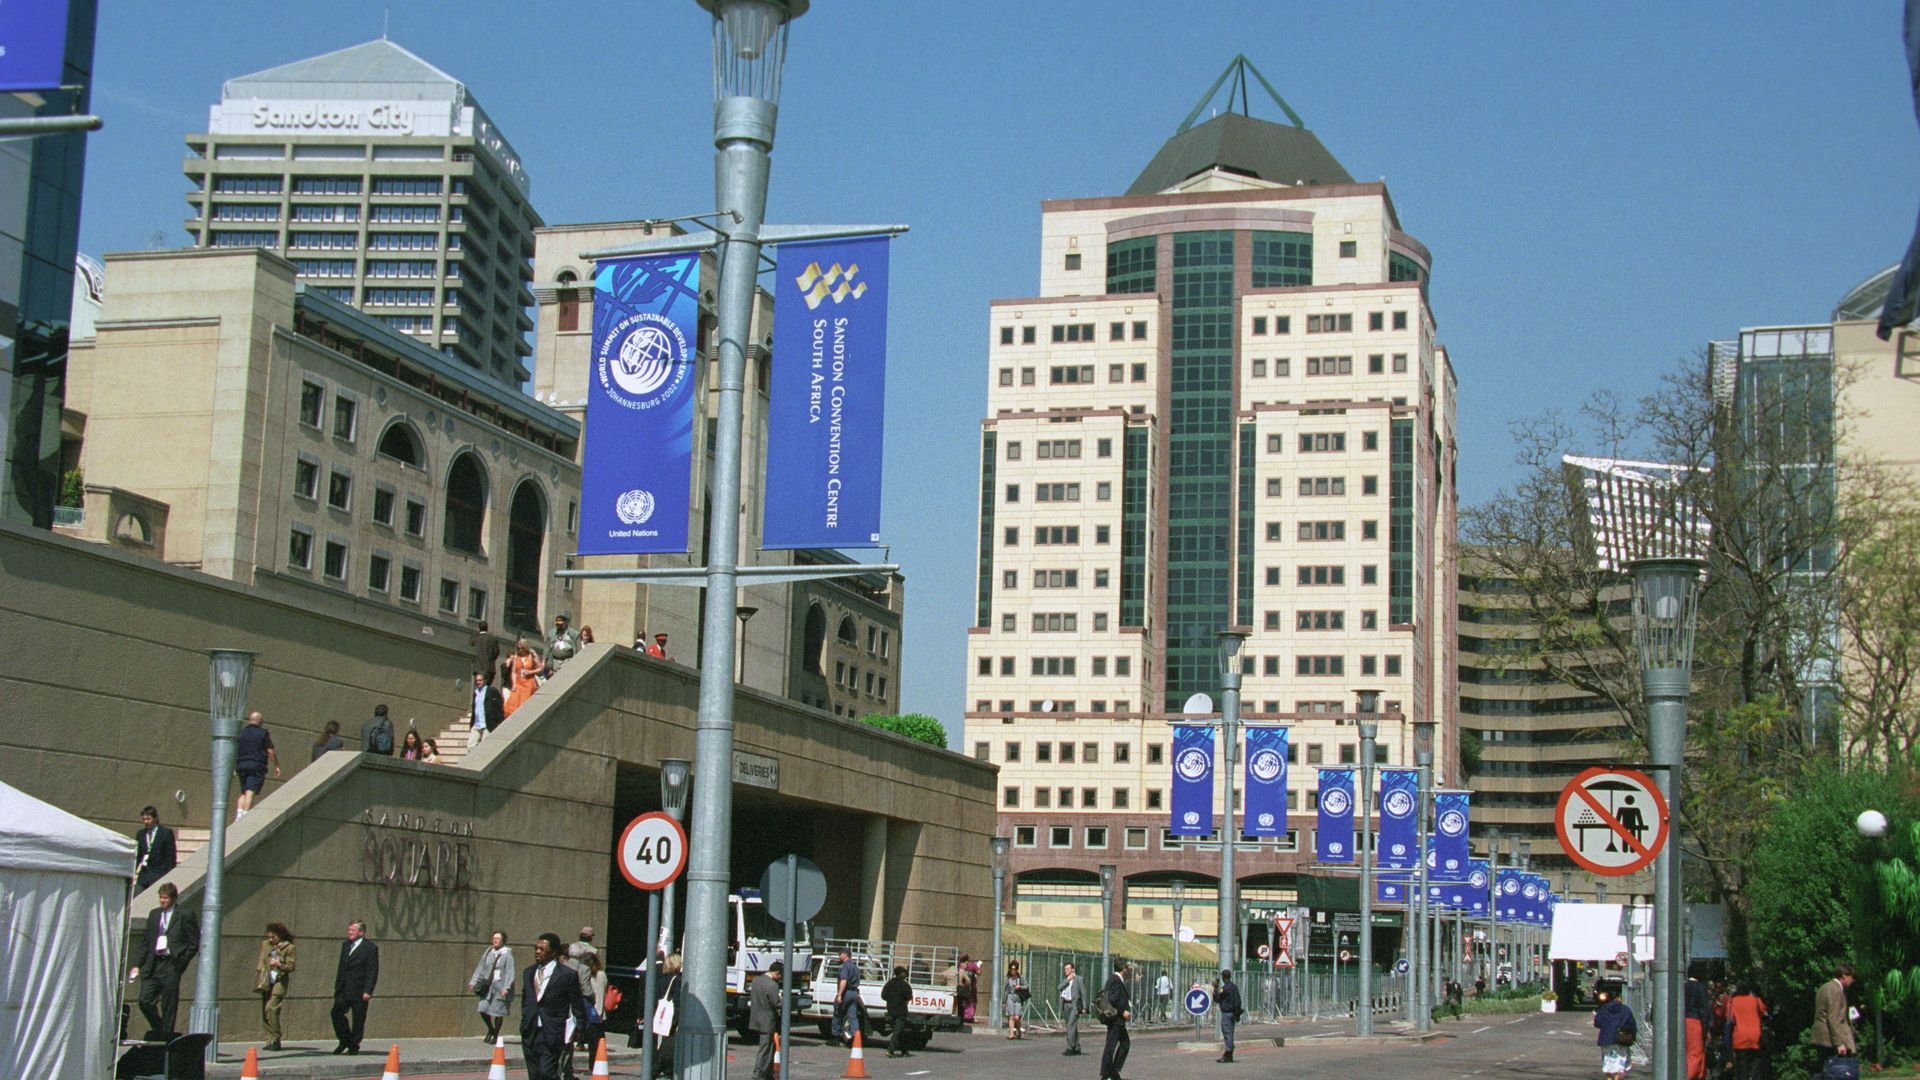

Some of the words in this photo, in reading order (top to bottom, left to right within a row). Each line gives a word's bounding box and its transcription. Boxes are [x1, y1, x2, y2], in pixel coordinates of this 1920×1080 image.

[254, 103, 360, 129] Sandton
[368, 103, 416, 136] City
[619, 319, 631, 330] ON
[629, 312, 676, 331] SUSTAINABLE
[601, 327, 621, 356] SUMMIT
[812, 319, 827, 369] SOUTH
[832, 317, 848, 382] SANDTON
[598, 357, 609, 386] WORLD
[606, 387, 661, 410] JOHANNESBURG
[661, 382, 678, 401] 2002
[809, 372, 825, 424] AFRICA
[828, 385, 846, 475] CONVENTION
[826, 478, 842, 529] CENTRE
[608, 530, 631, 538] United
[632, 529, 659, 537] Nations
[363, 808, 474, 837] SANDTON
[363, 830, 472, 891] SQUARE
[635, 836, 672, 865] 40
[911, 996, 946, 1008] ISSAN
